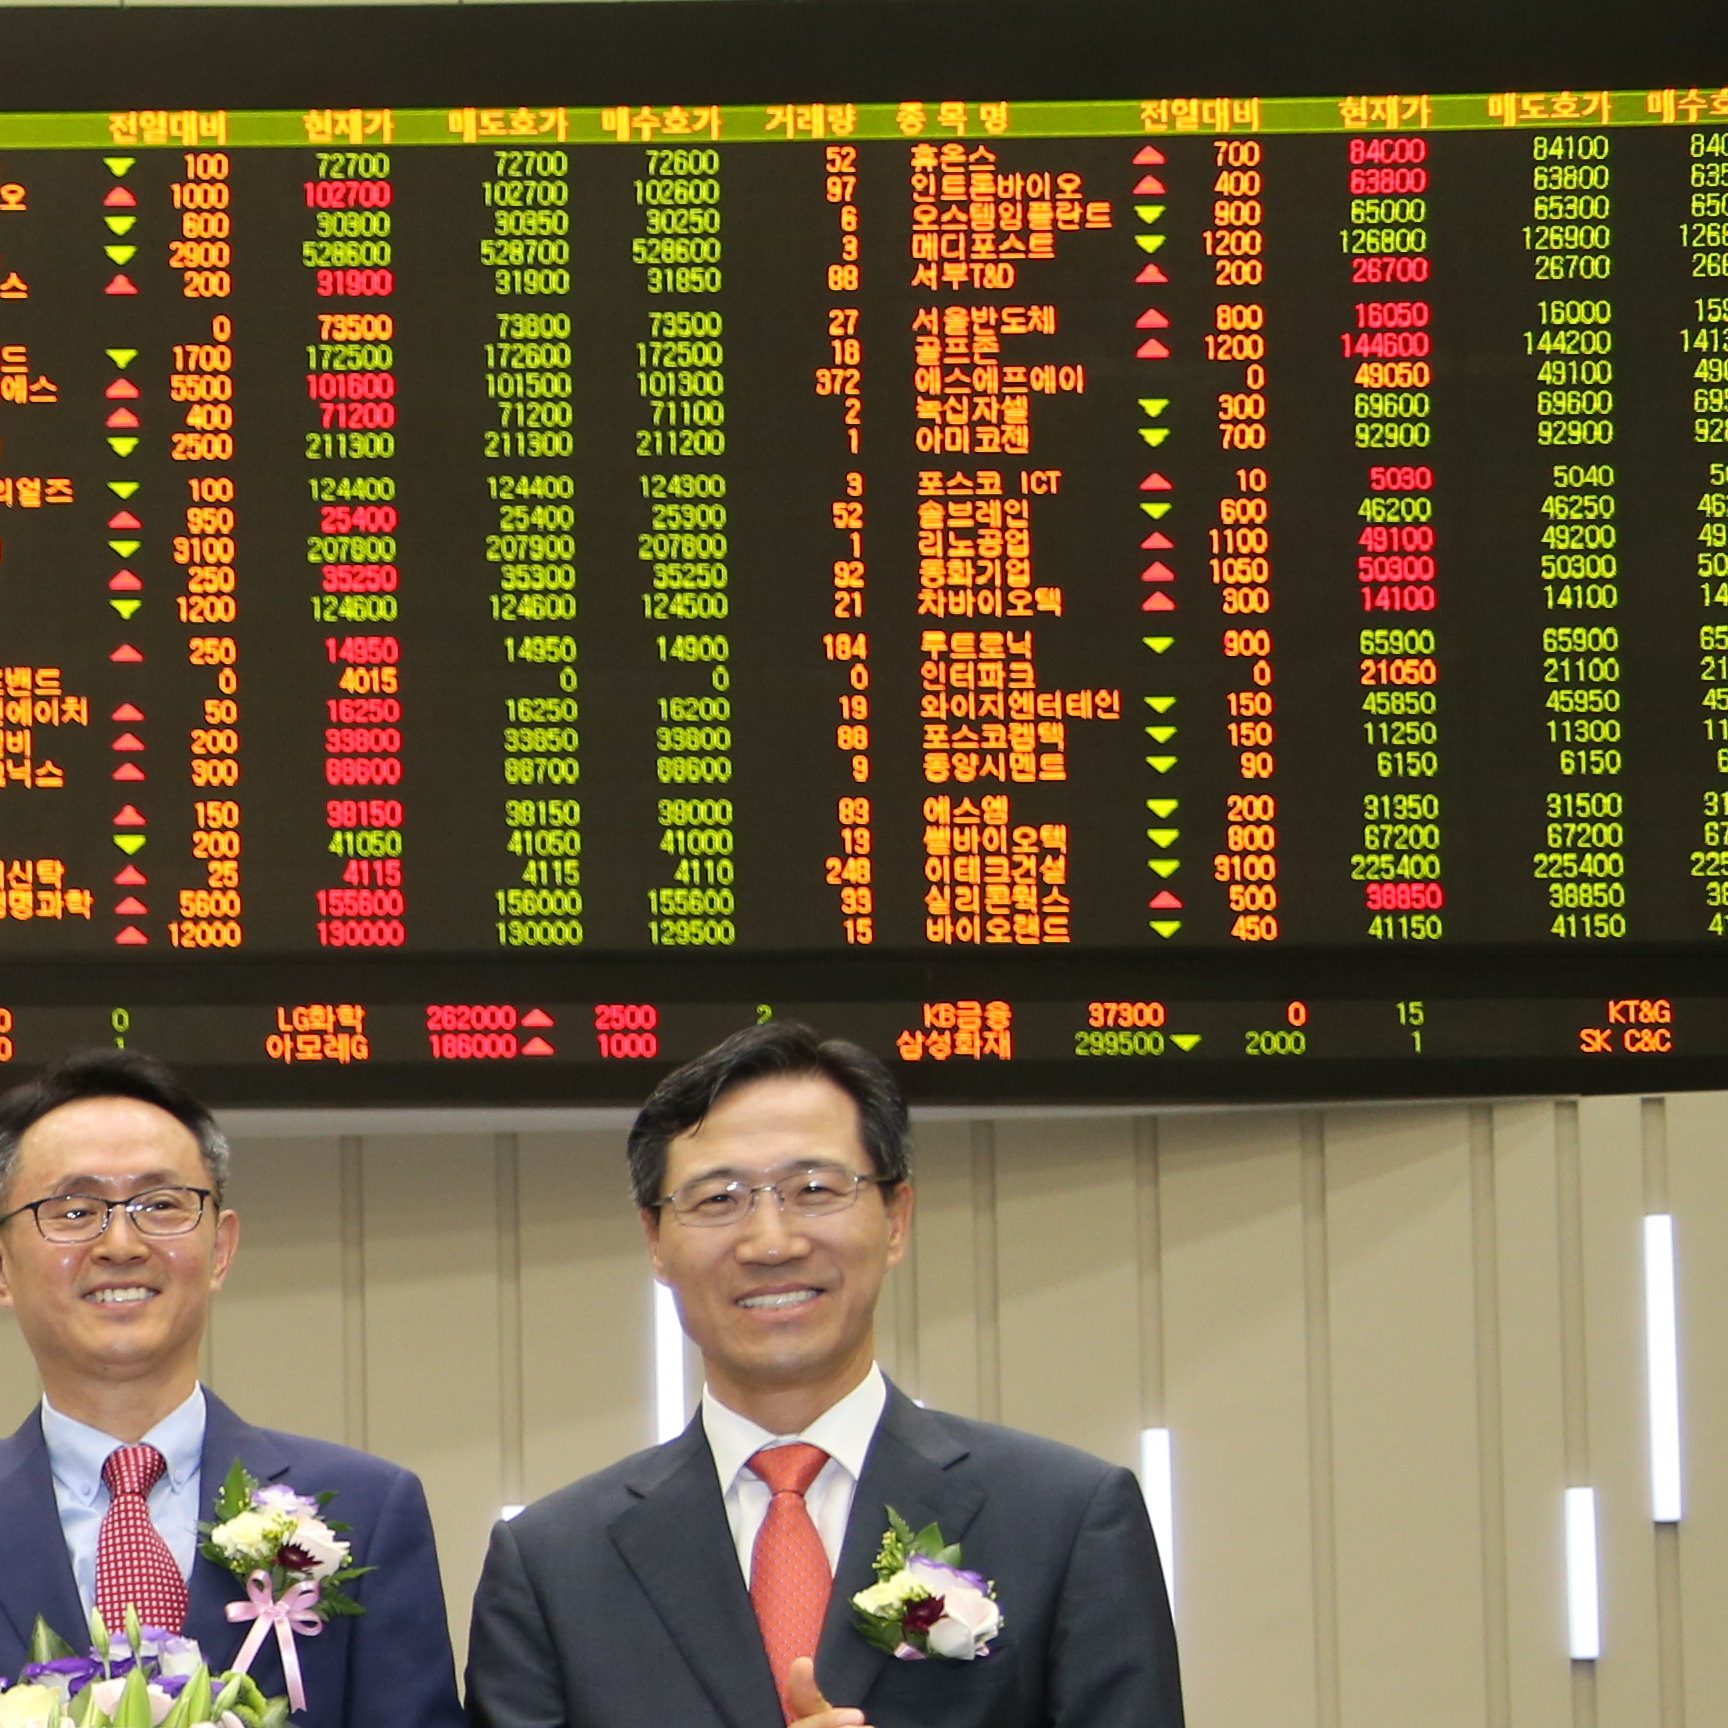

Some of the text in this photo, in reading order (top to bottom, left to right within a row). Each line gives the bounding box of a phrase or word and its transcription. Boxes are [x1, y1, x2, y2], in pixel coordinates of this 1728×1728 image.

[109, 111, 227, 145] 전일대비
[303, 109, 394, 144] 현재가
[448, 108, 569, 142] 매도호가
[601, 106, 722, 141] 매수호가
[765, 104, 856, 139] 거래량
[1140, 98, 1262, 132] 전일대비
[1338, 95, 1432, 129] 현재가
[1488, 92, 1612, 126] 매도호가
[170, 182, 232, 210] 1000
[1535, 255, 1611, 279] 26700
[1538, 300, 1611, 324] 16000
[1524, 330, 1611, 354] 144200
[319, 402, 397, 430] 71200
[1538, 420, 1614, 445] 92900
[1021, 470, 1062, 494] ICT
[1554, 465, 1614, 487] 5040
[1544, 584, 1618, 609] 14100
[338, 666, 400, 694] 4015
[1544, 657, 1619, 682] 21100
[1561, 750, 1621, 775] 6150
[522, 859, 579, 886] 4115
[1534, 852, 1624, 878] 225400
[1551, 913, 1626, 937] 41150
[274, 1004, 366, 1037] LG화학
[426, 1005, 519, 1033] 262000
[595, 1004, 658, 1033] 2500
[924, 1001, 1012, 1031] KB금융
[1398, 1002, 1423, 1025] 15
[1608, 999, 1672, 1023] KT&G
[266, 1031, 371, 1064] 아모레G
[597, 1030, 658, 1058] 1000
[896, 1029, 1012, 1060] 삼성화재
[1246, 1031, 1305, 1054] 2000
[1580, 1029, 1612, 1052] SK
[1624, 1028, 1672, 1052] C&C
